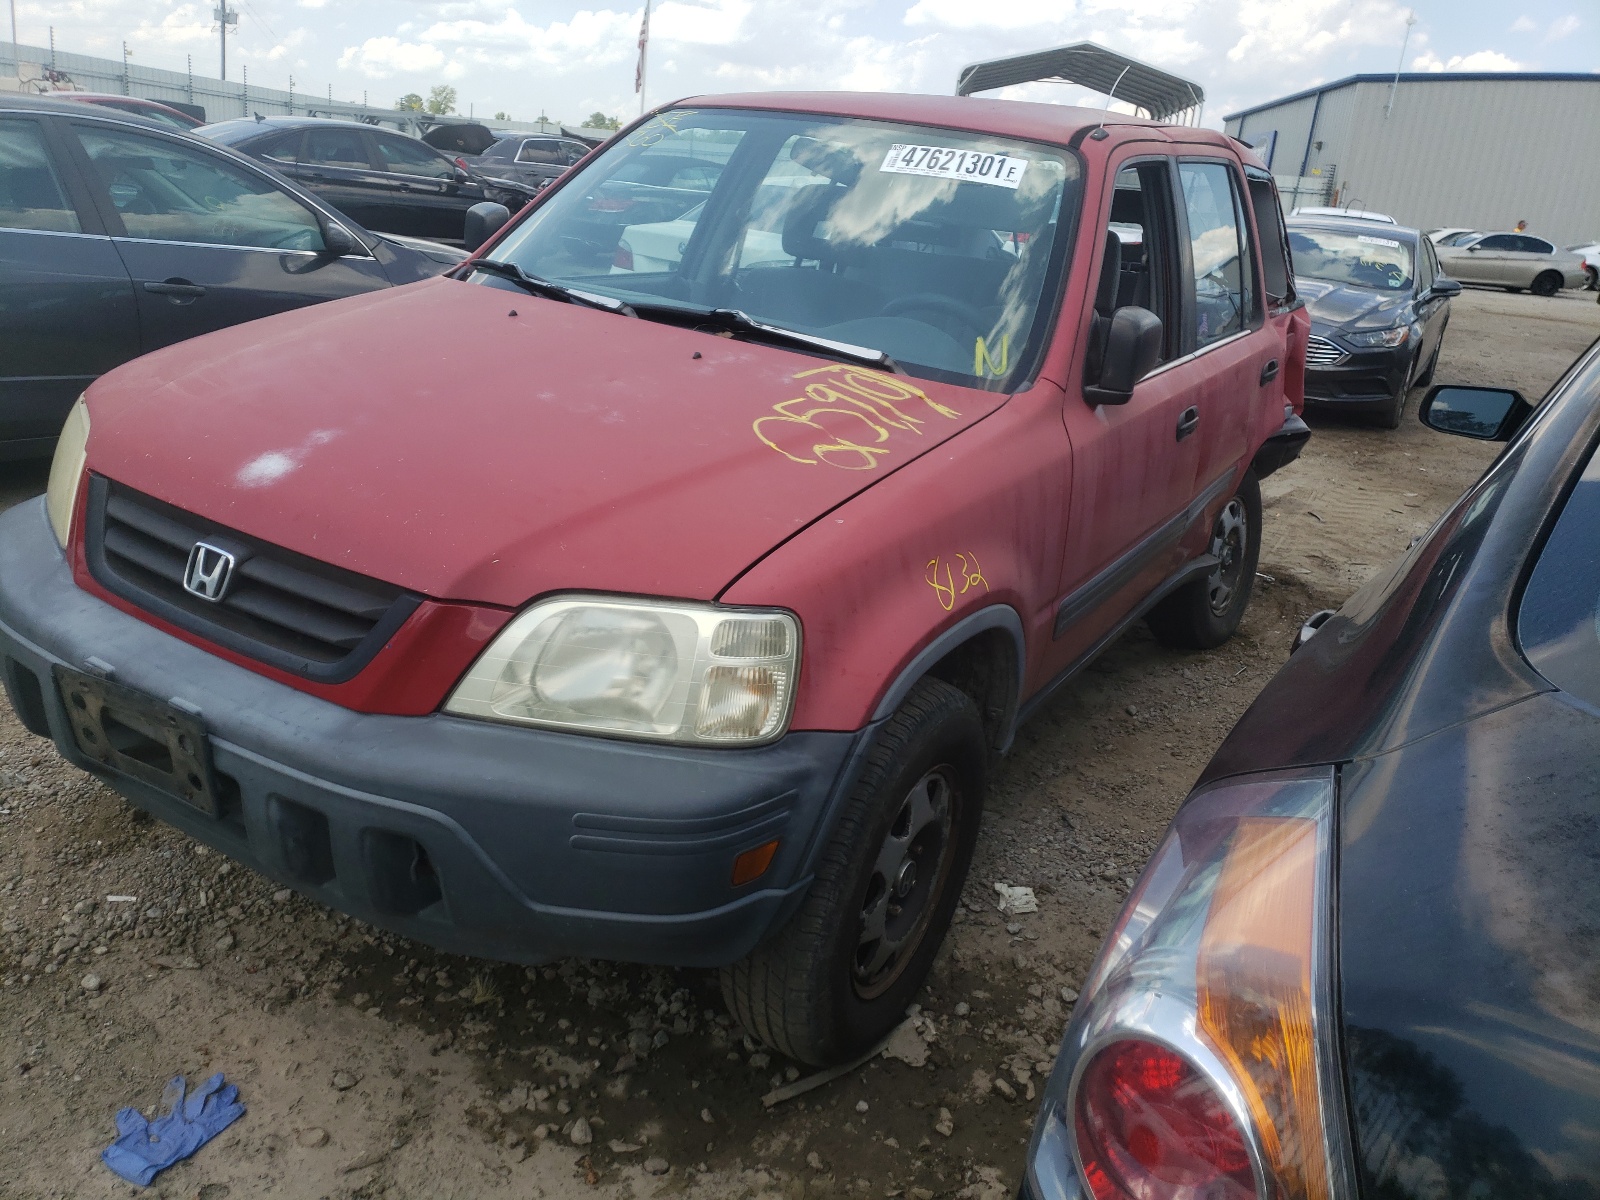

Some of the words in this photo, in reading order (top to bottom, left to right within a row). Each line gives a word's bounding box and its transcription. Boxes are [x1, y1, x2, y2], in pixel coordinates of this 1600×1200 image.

[901, 146, 1007, 179] 47621301
[1006, 167, 1017, 178] F
[975, 334, 1009, 377] N
